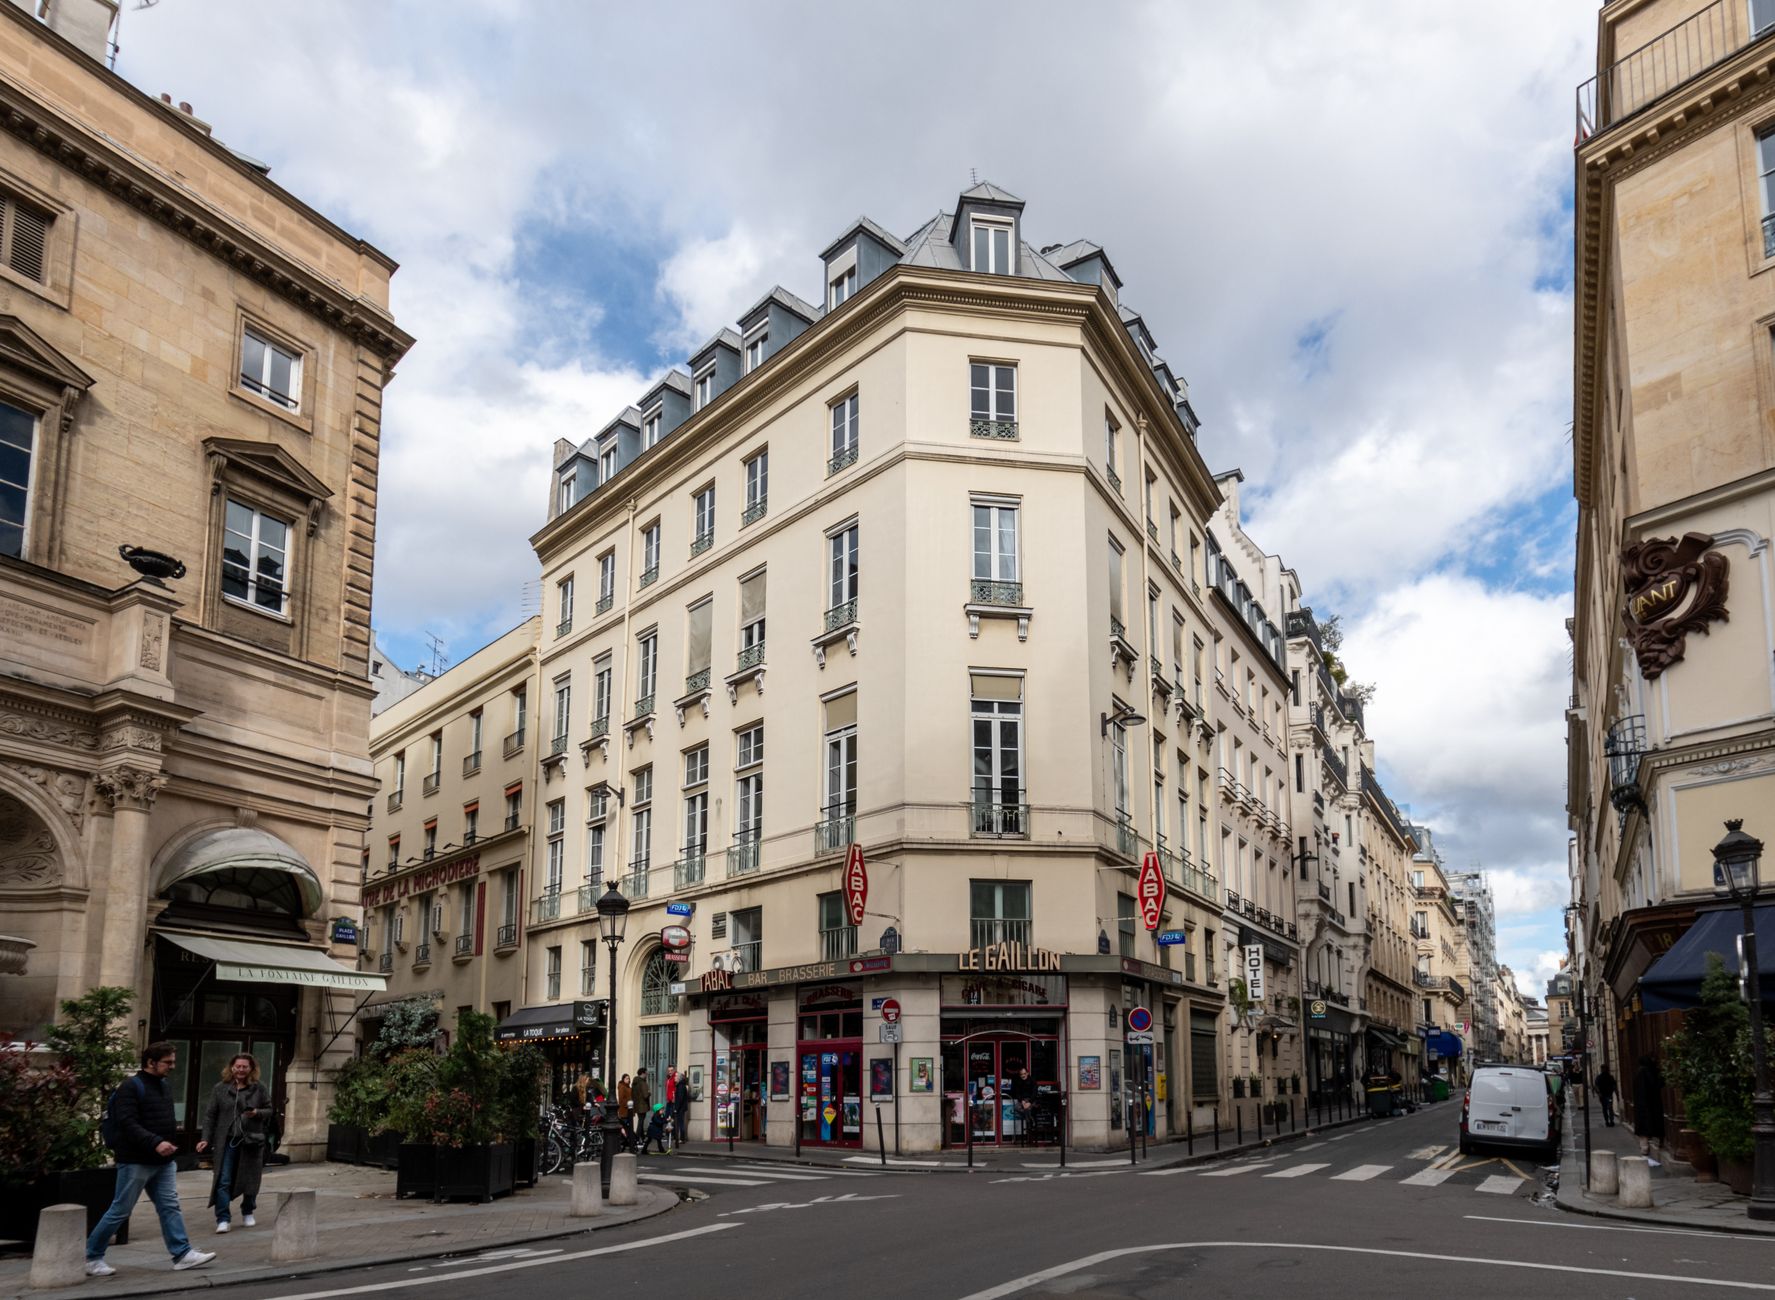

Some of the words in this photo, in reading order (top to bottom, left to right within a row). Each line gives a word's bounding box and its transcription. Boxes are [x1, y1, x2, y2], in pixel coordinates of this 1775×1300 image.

[383, 881, 395, 902] DE
[397, 878, 409, 898] LA
[851, 846, 864, 921] TABAC
[1143, 853, 1159, 926] TABAC
[959, 948, 980, 970] LE
[985, 939, 1061, 970] GAILLON
[1656, 932, 1674, 950] 18
[665, 953, 688, 961] BRASSERIE
[238, 968, 253, 978] LA
[260, 969, 317, 982] FONTAINE
[322, 976, 369, 987] GAILLON
[700, 969, 731, 992] TABAC
[748, 972, 768, 985] BAR
[779, 962, 835, 983] BRASSERIE
[1248, 947, 1261, 999] HOTEL
[523, 1029, 529, 1037] LA
[529, 1028, 543, 1037] TOQUE
